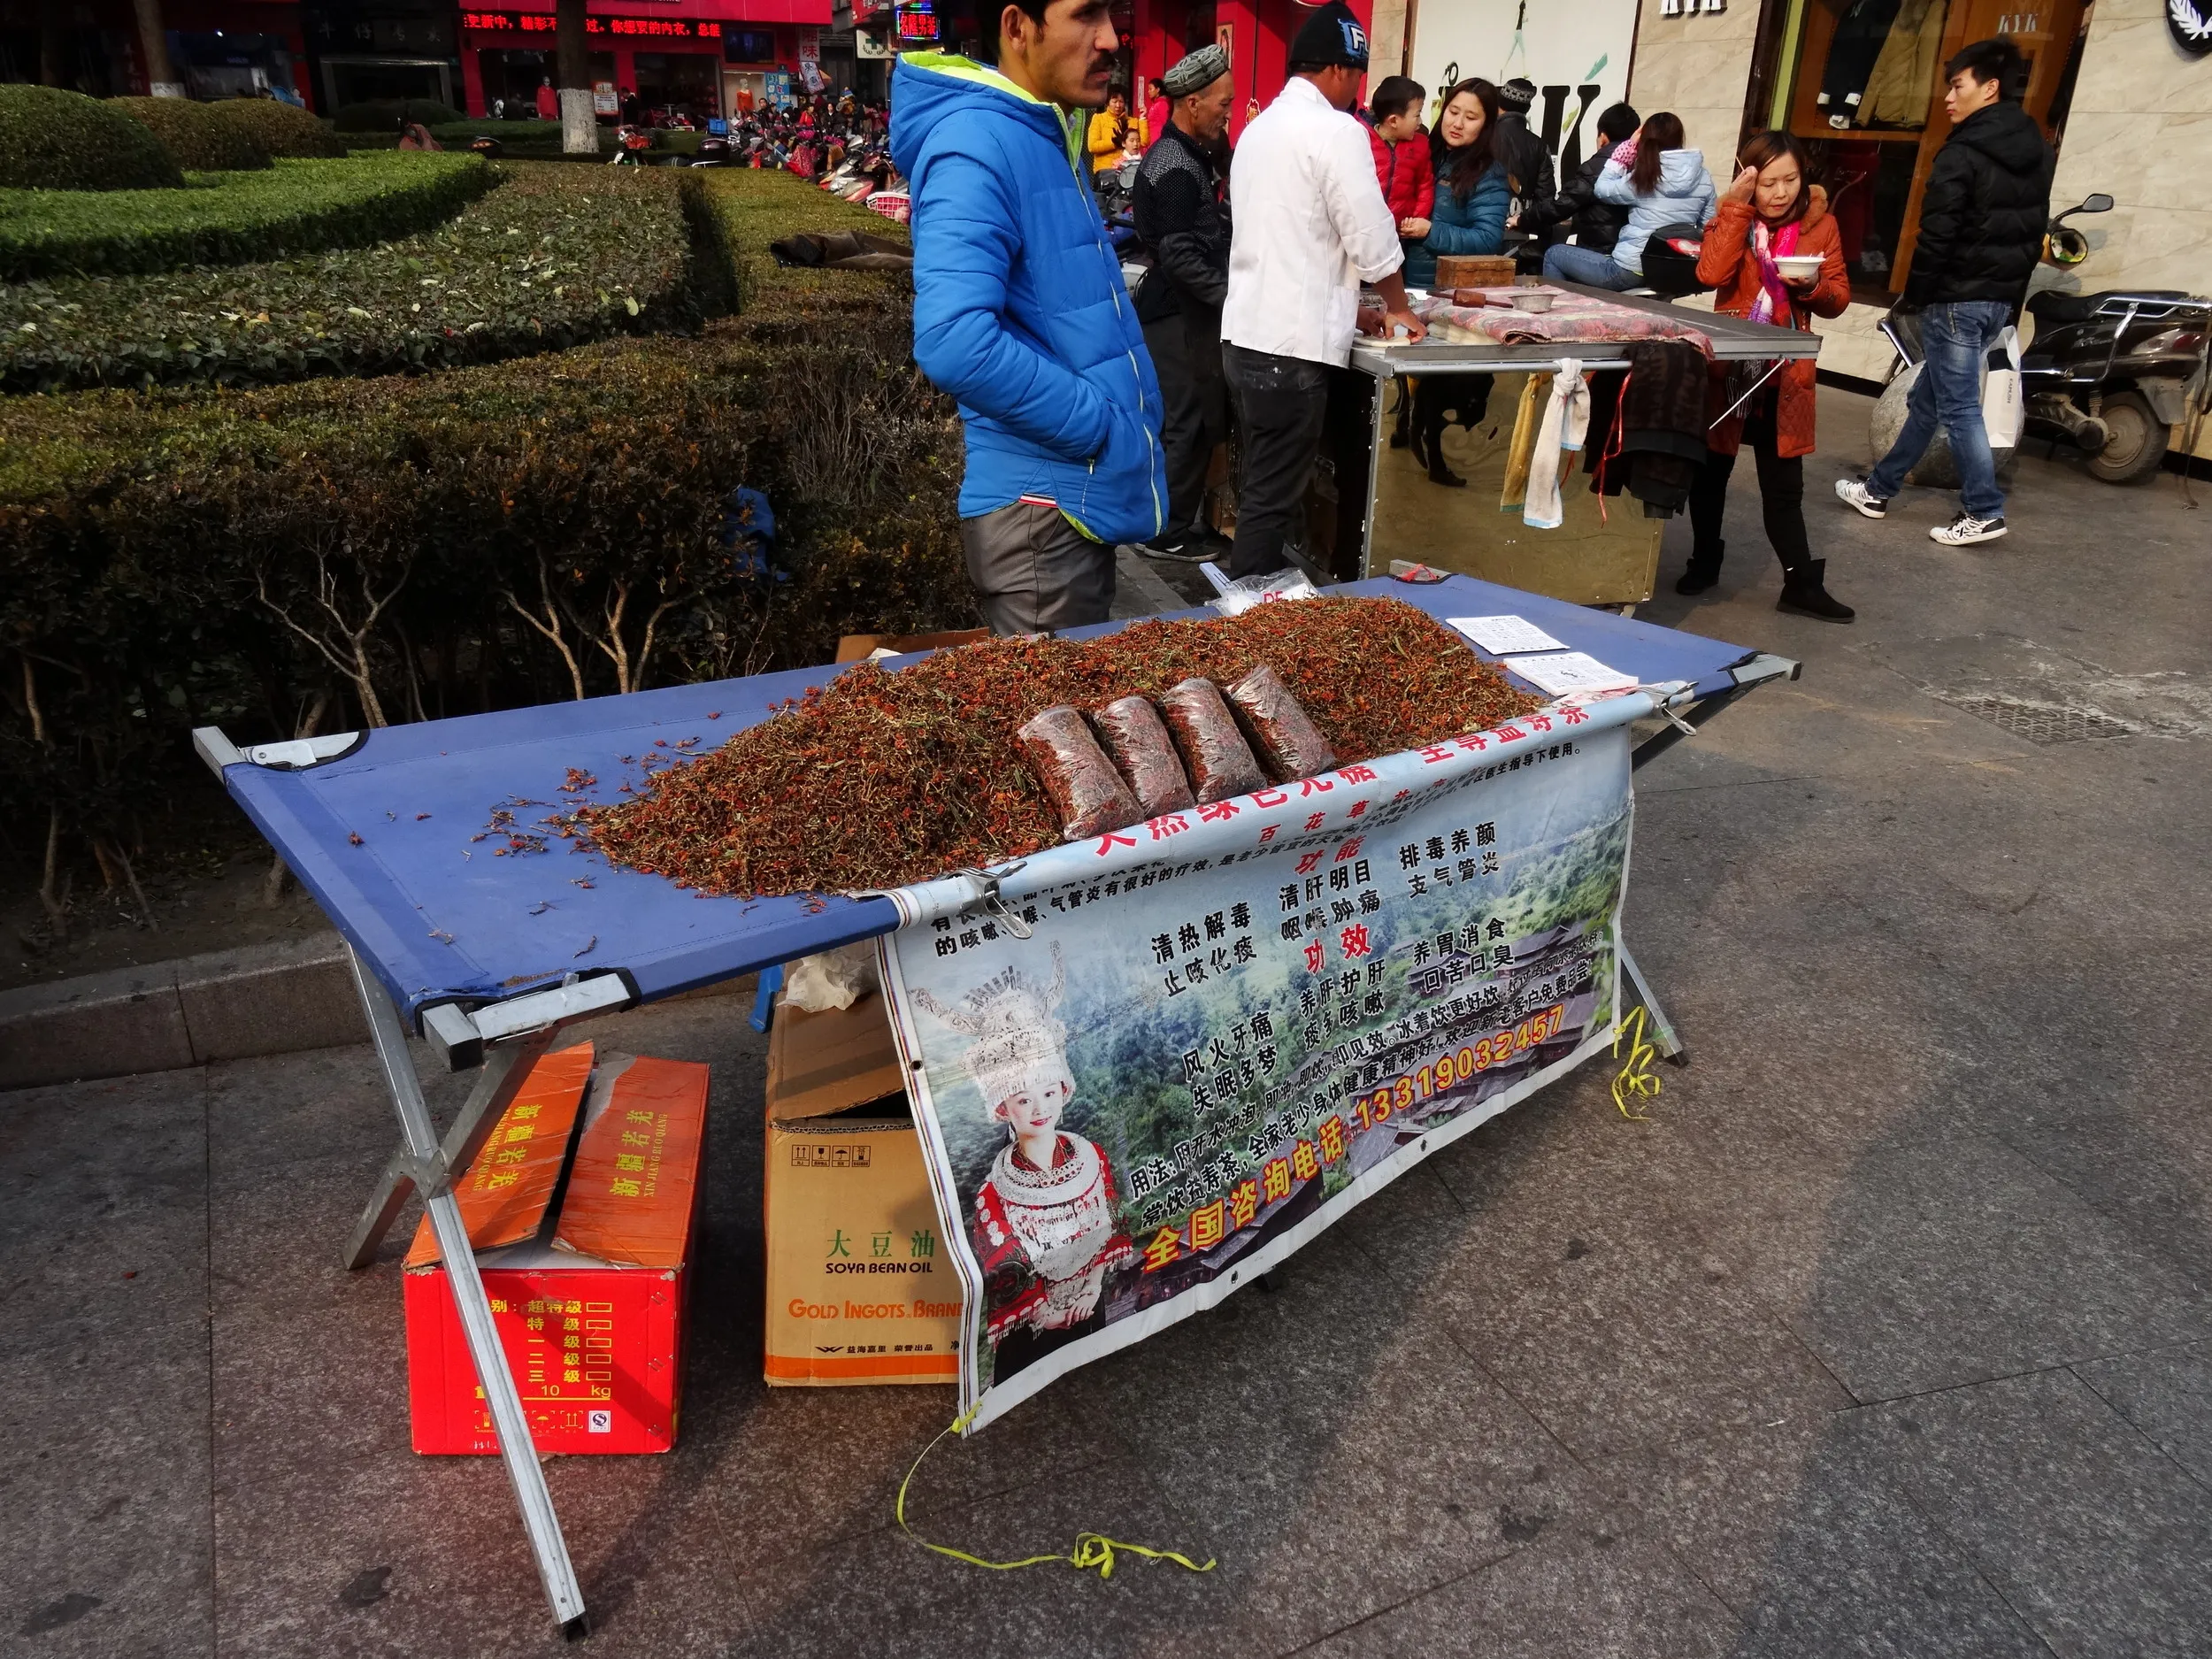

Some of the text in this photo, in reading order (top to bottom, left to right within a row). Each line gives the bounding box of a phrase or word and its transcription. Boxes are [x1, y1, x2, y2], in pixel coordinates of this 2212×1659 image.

[1294, 834, 1367, 875] 功能
[1151, 821, 1497, 965] 清热解毒 清肝明目 排毒养颜
[1164, 850, 1501, 998] 止咳化痰 咽喉肿痛 支气管炎
[1303, 923, 1371, 975] 功效
[1183, 918, 1506, 1083] 风火牙痛 养肝护肝 养胃消食
[1192, 944, 1516, 1116] 失眠多梦 痰多咳嗽 口苦口臭
[826, 1230, 935, 1258] 大豆油
[826, 1262, 933, 1274] SOYA BEAN OIL
[528, 1300, 582, 1314] 超特级
[541, 1385, 611, 1400] 10 kg
